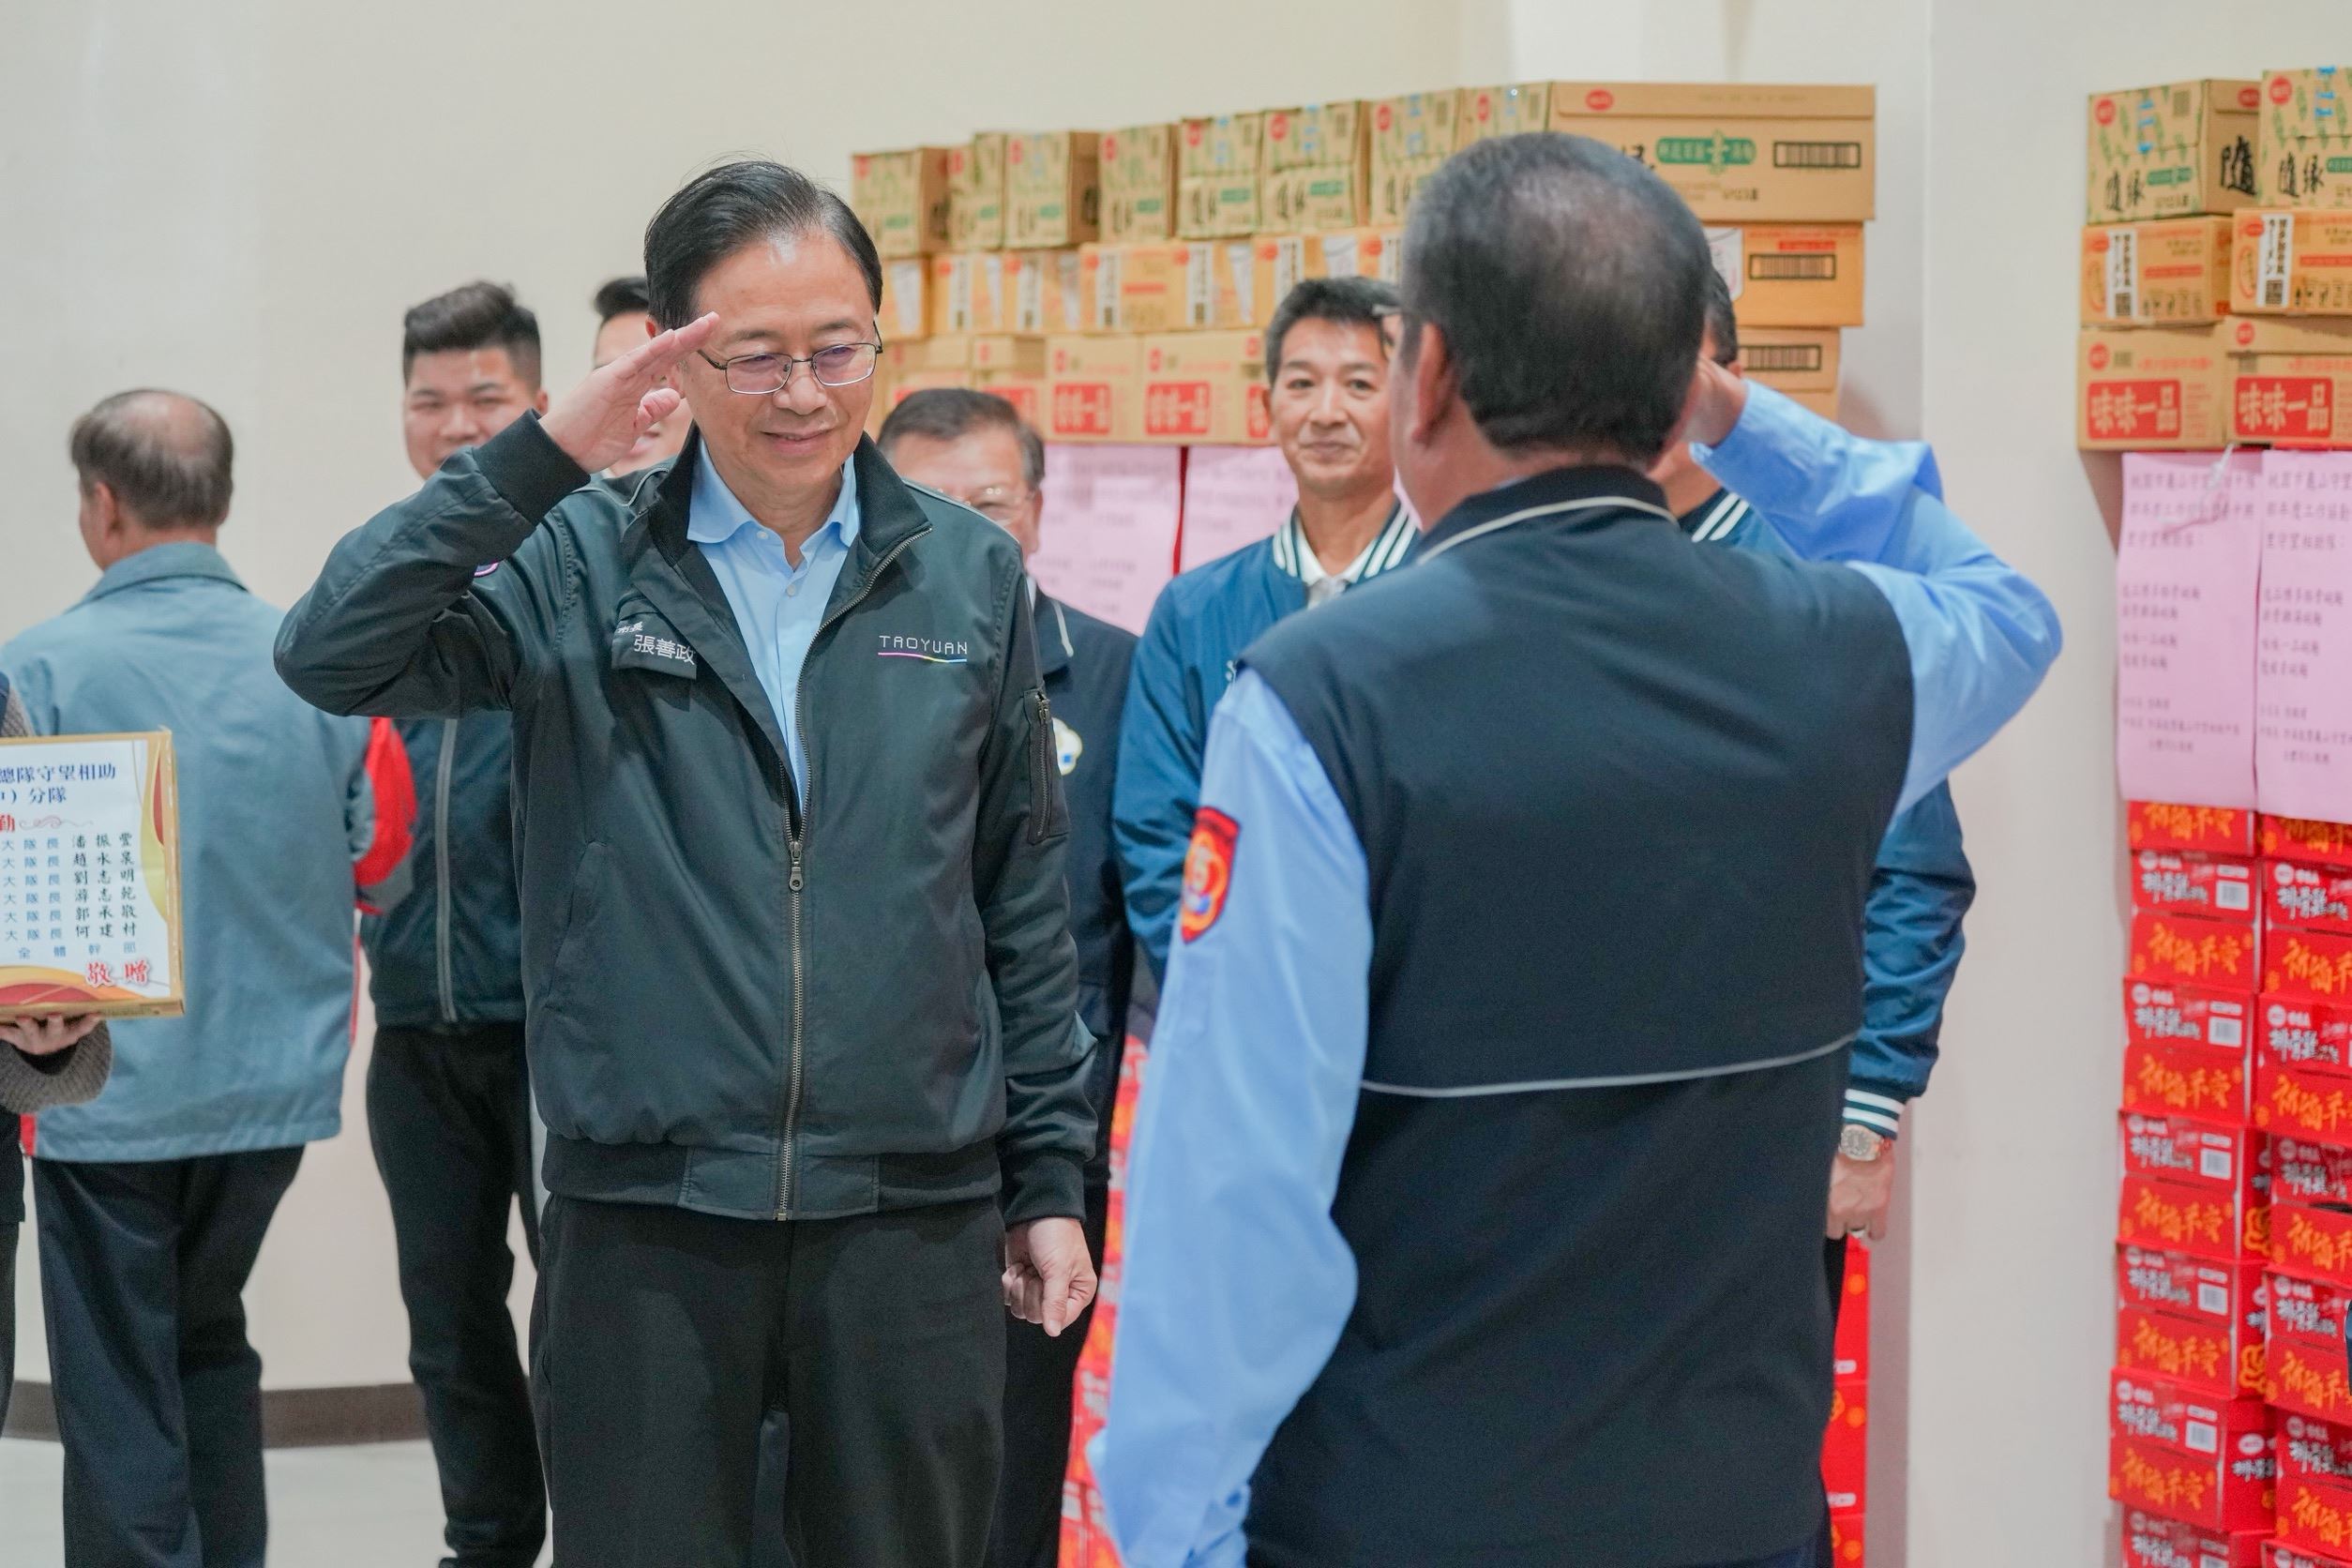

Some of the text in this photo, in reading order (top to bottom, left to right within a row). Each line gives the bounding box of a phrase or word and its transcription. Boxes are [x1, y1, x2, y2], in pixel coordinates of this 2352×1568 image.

[2238, 383, 2329, 432] 味味一品
[634, 634, 695, 665] 張善政
[879, 635, 968, 656] TAOYUAN
